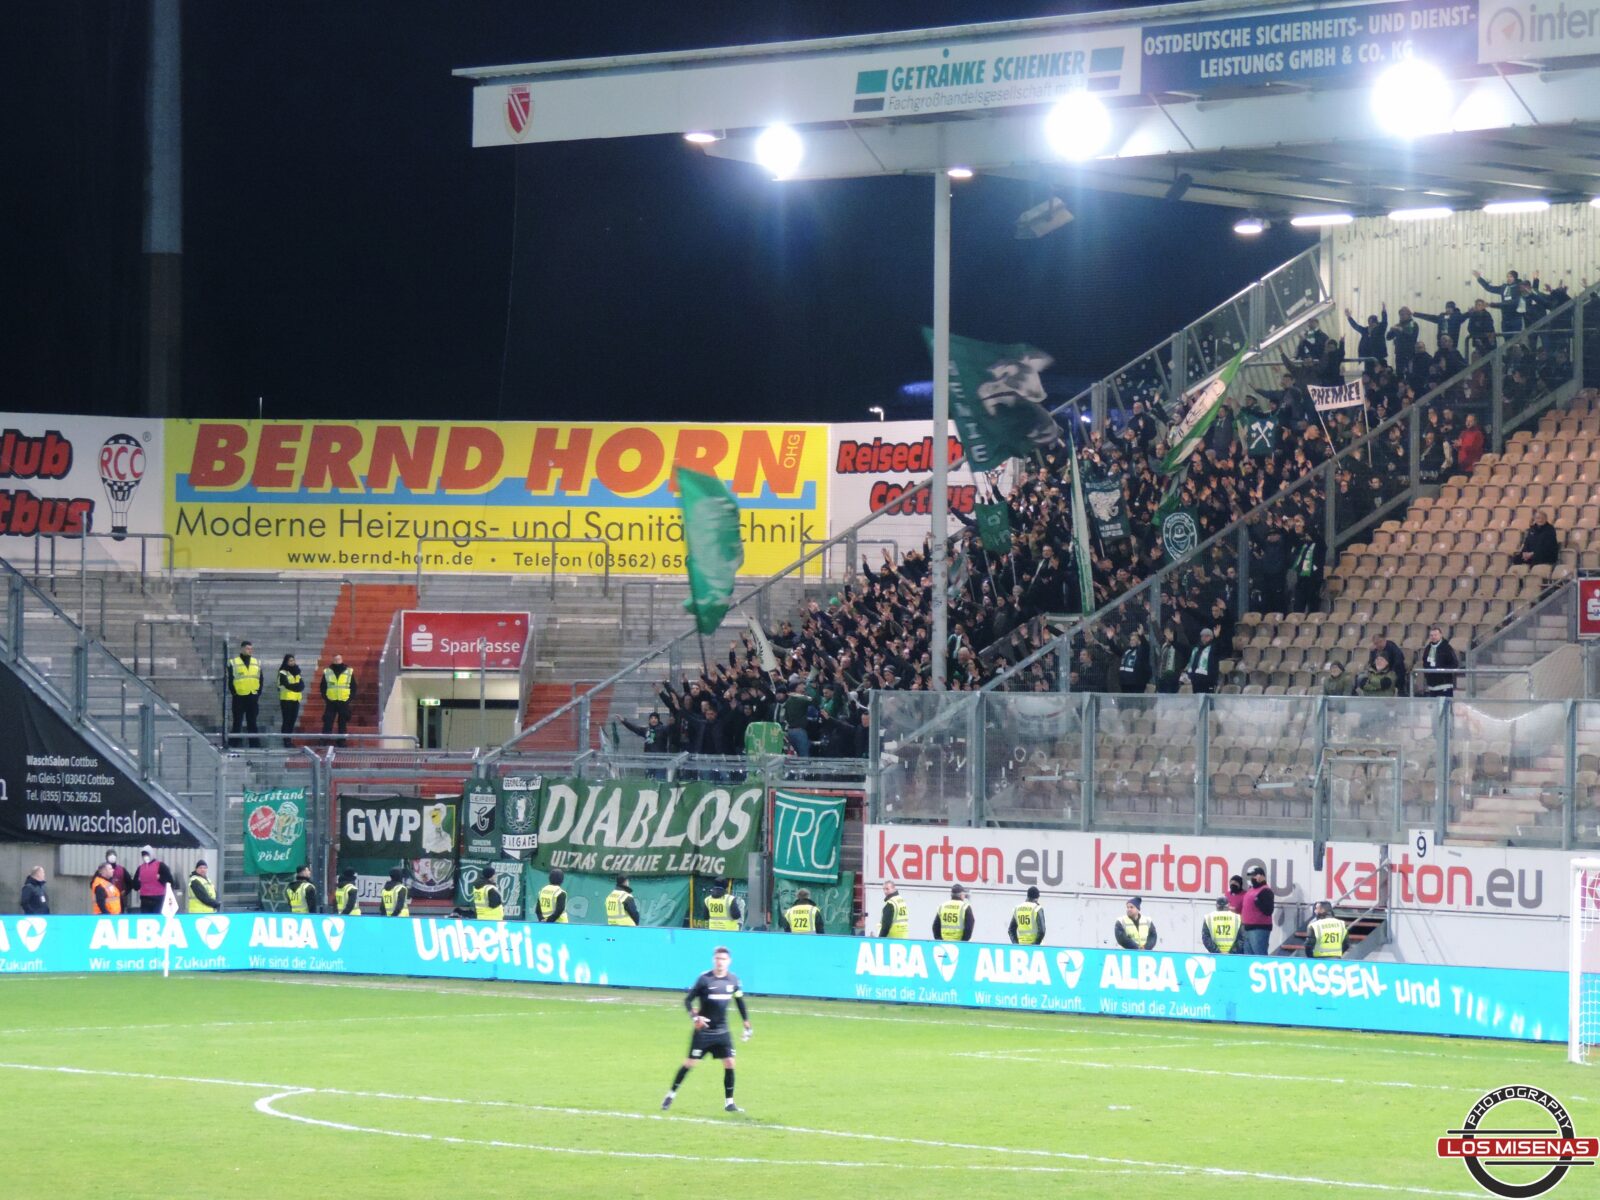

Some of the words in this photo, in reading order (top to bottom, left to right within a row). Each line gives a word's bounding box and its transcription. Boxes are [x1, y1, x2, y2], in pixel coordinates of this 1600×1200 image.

[1143, 27, 1251, 57] OSTDEUTSCHE
[1255, 18, 1363, 48] SICHERHEITS-
[1368, 13, 1405, 34] UND
[1410, 5, 1477, 32] DIENST-
[890, 47, 985, 92] GETRÄNKE
[993, 50, 1086, 83] SCHENKER
[1200, 49, 1285, 79] LEISTUNGS
[1288, 45, 1337, 71] GMBH
[1340, 43, 1352, 63] &
[1358, 40, 1386, 63] CO.
[888, 83, 1051, 113] Fachgroßhandelsgesellschaft
[100, 446, 144, 481] RCC
[188, 423, 503, 491] BERND
[525, 427, 806, 495] HORN
[783, 433, 801, 469] OHG
[836, 436, 964, 473] Reiseclb
[869, 480, 977, 515] Cottus
[177, 506, 326, 538] Moderne
[339, 509, 500, 548] Heizungs-
[512, 512, 572, 541] und
[584, 511, 814, 543] Sanitähnik
[287, 550, 474, 566] www.bernd-horn.de
[513, 551, 583, 567] Telefon
[587, 551, 659, 570] (03562)
[662, 554, 688, 569] 65
[440, 638, 521, 656] Sparkasse
[26, 755, 69, 767] WaschSalon
[70, 755, 98, 768] Cottbus
[26, 772, 37, 783] Am
[38, 772, 56, 784] Gleis
[56, 774, 61, 784] 5
[65, 773, 86, 785] 03042
[87, 774, 114, 786] Cottbus
[26, 790, 39, 801] Tel.
[40, 790, 61, 803] (0355)
[62, 791, 75, 802] 756
[75, 792, 88, 802] 266
[88, 792, 102, 803] 251
[26, 809, 181, 835] www.waschsalon.eu
[346, 807, 421, 842] GWP
[537, 783, 764, 851] DIABLOS
[774, 800, 840, 870] TRC
[1416, 835, 1428, 859] 9
[601, 852, 663, 874] CHEMIE
[878, 830, 1064, 887] karton.eu
[1325, 847, 1544, 909] katon.eu
[709, 902, 724, 914] 280
[793, 917, 808, 928] 272
[942, 912, 958, 924] 465
[89, 918, 188, 949] ALBA
[249, 916, 319, 949] ALBA
[1215, 925, 1231, 936] 472
[1324, 932, 1340, 944] 261
[89, 958, 110, 970] Wir
[116, 957, 145, 970] sind
[175, 955, 231, 970] Zukunft.
[250, 955, 267, 969] Wir
[269, 956, 289, 970] sind
[291, 956, 307, 970] die
[309, 957, 347, 971] Zukunft.
[856, 942, 929, 979] ALBA
[974, 948, 1051, 986] ALBA
[1100, 953, 1180, 992] ALBA
[856, 983, 873, 997] Wir
[875, 984, 896, 999] sind
[898, 985, 916, 1000] die
[918, 986, 960, 1003] Zukunft.
[1249, 961, 1388, 1000] STRASSEN-
[1394, 977, 1441, 1009] und
[975, 991, 993, 1006] Wir
[995, 992, 1018, 1008] sind
[1020, 993, 1038, 1009] die
[1040, 995, 1086, 1012] Zukunft.
[1100, 999, 1118, 1013] Wir
[1120, 1000, 1145, 1015] sind
[1147, 1002, 1166, 1017] die
[1168, 1003, 1215, 1020] Zukunft.
